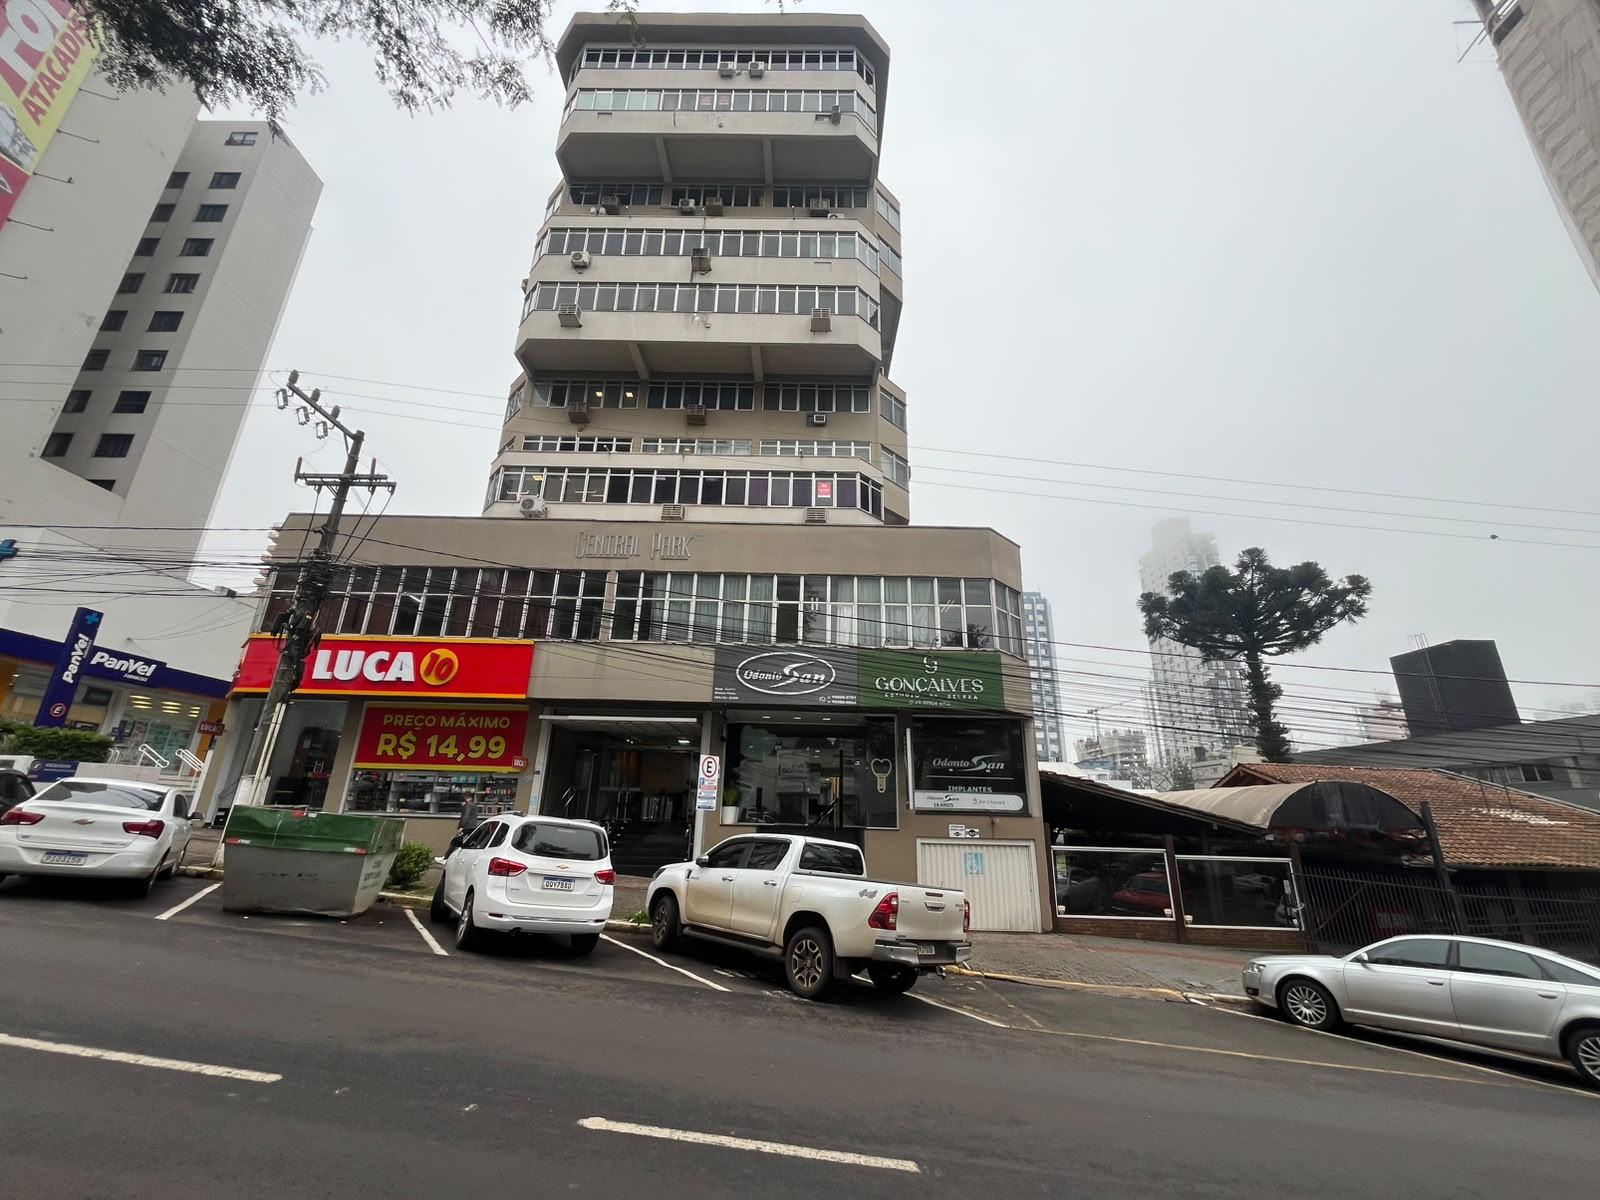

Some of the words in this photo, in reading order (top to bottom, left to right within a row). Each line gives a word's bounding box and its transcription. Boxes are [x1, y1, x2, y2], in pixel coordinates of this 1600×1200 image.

[575, 531, 640, 559] CENTRAL
[650, 532, 692, 560] PARK
[311, 649, 416, 683] LUCA
[423, 651, 455, 681] 10
[875, 676, 984, 694] GONÇALVES
[53, 706, 63, 714] E
[383, 713, 437, 731] PREÇO
[440, 712, 511, 729] MÁXIMO
[376, 730, 417, 760] R$
[426, 734, 507, 763] 14,99
[706, 760, 713, 774] E
[932, 757, 970, 768] Odonto
[960, 754, 1005, 772] San
[948, 785, 993, 793] IMPLANTES
